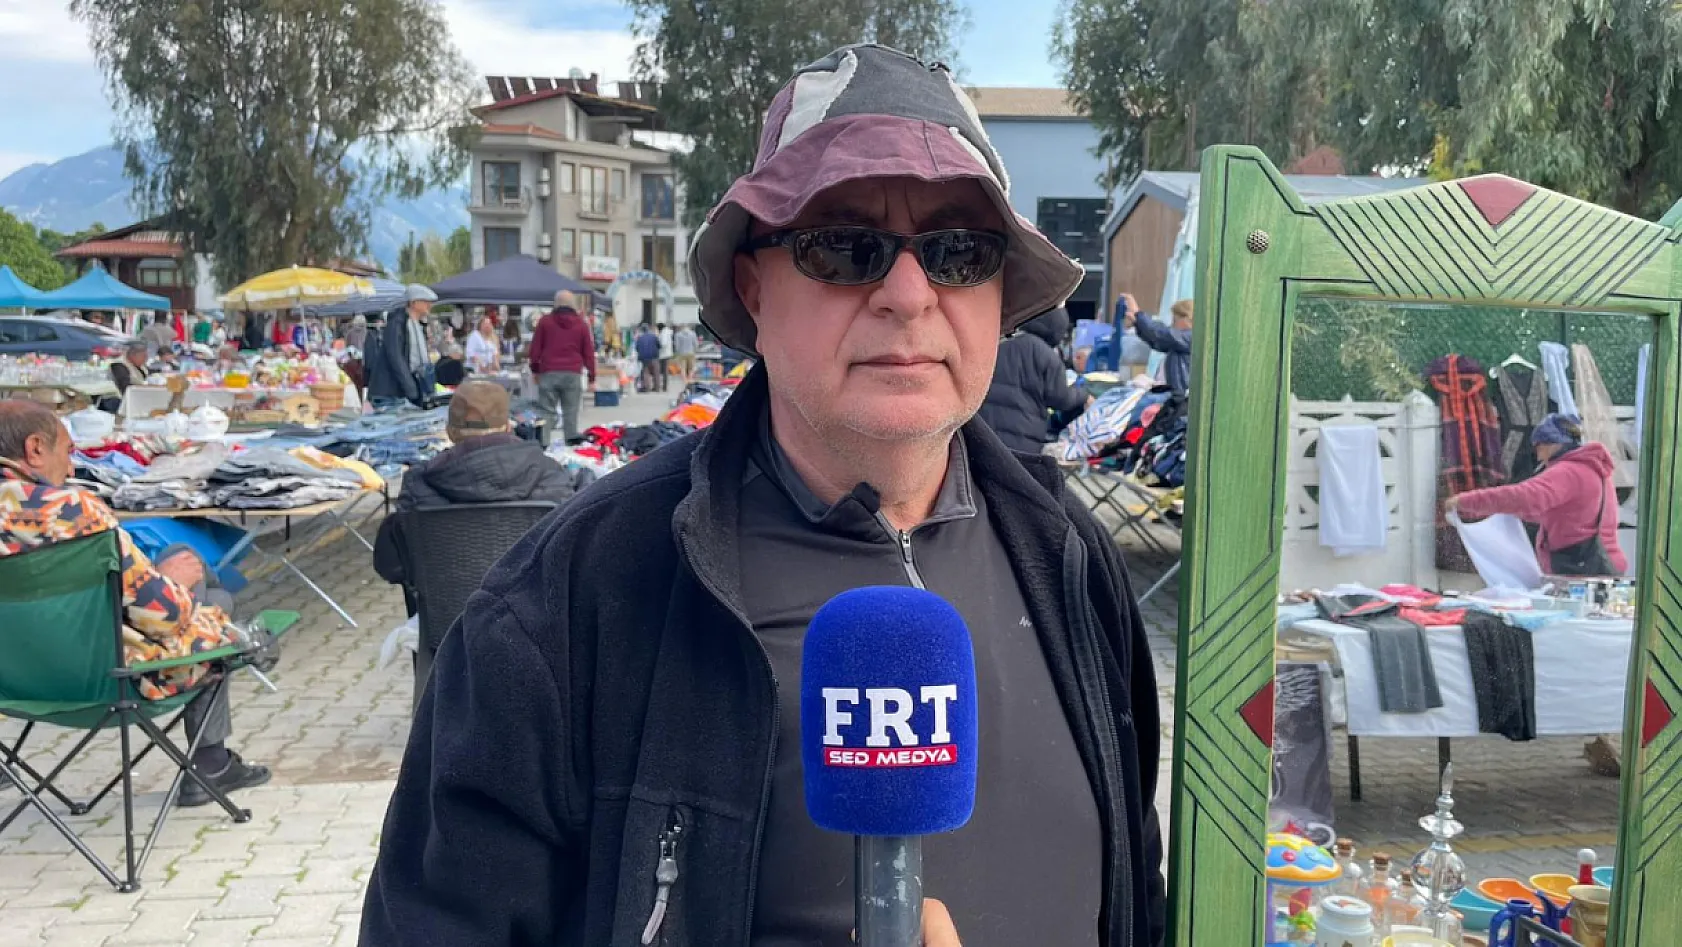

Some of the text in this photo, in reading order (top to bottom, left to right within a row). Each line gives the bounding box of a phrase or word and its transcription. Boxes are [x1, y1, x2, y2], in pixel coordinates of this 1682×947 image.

[822, 685, 957, 747] FRT
[829, 748, 952, 765] SED MEDYA
